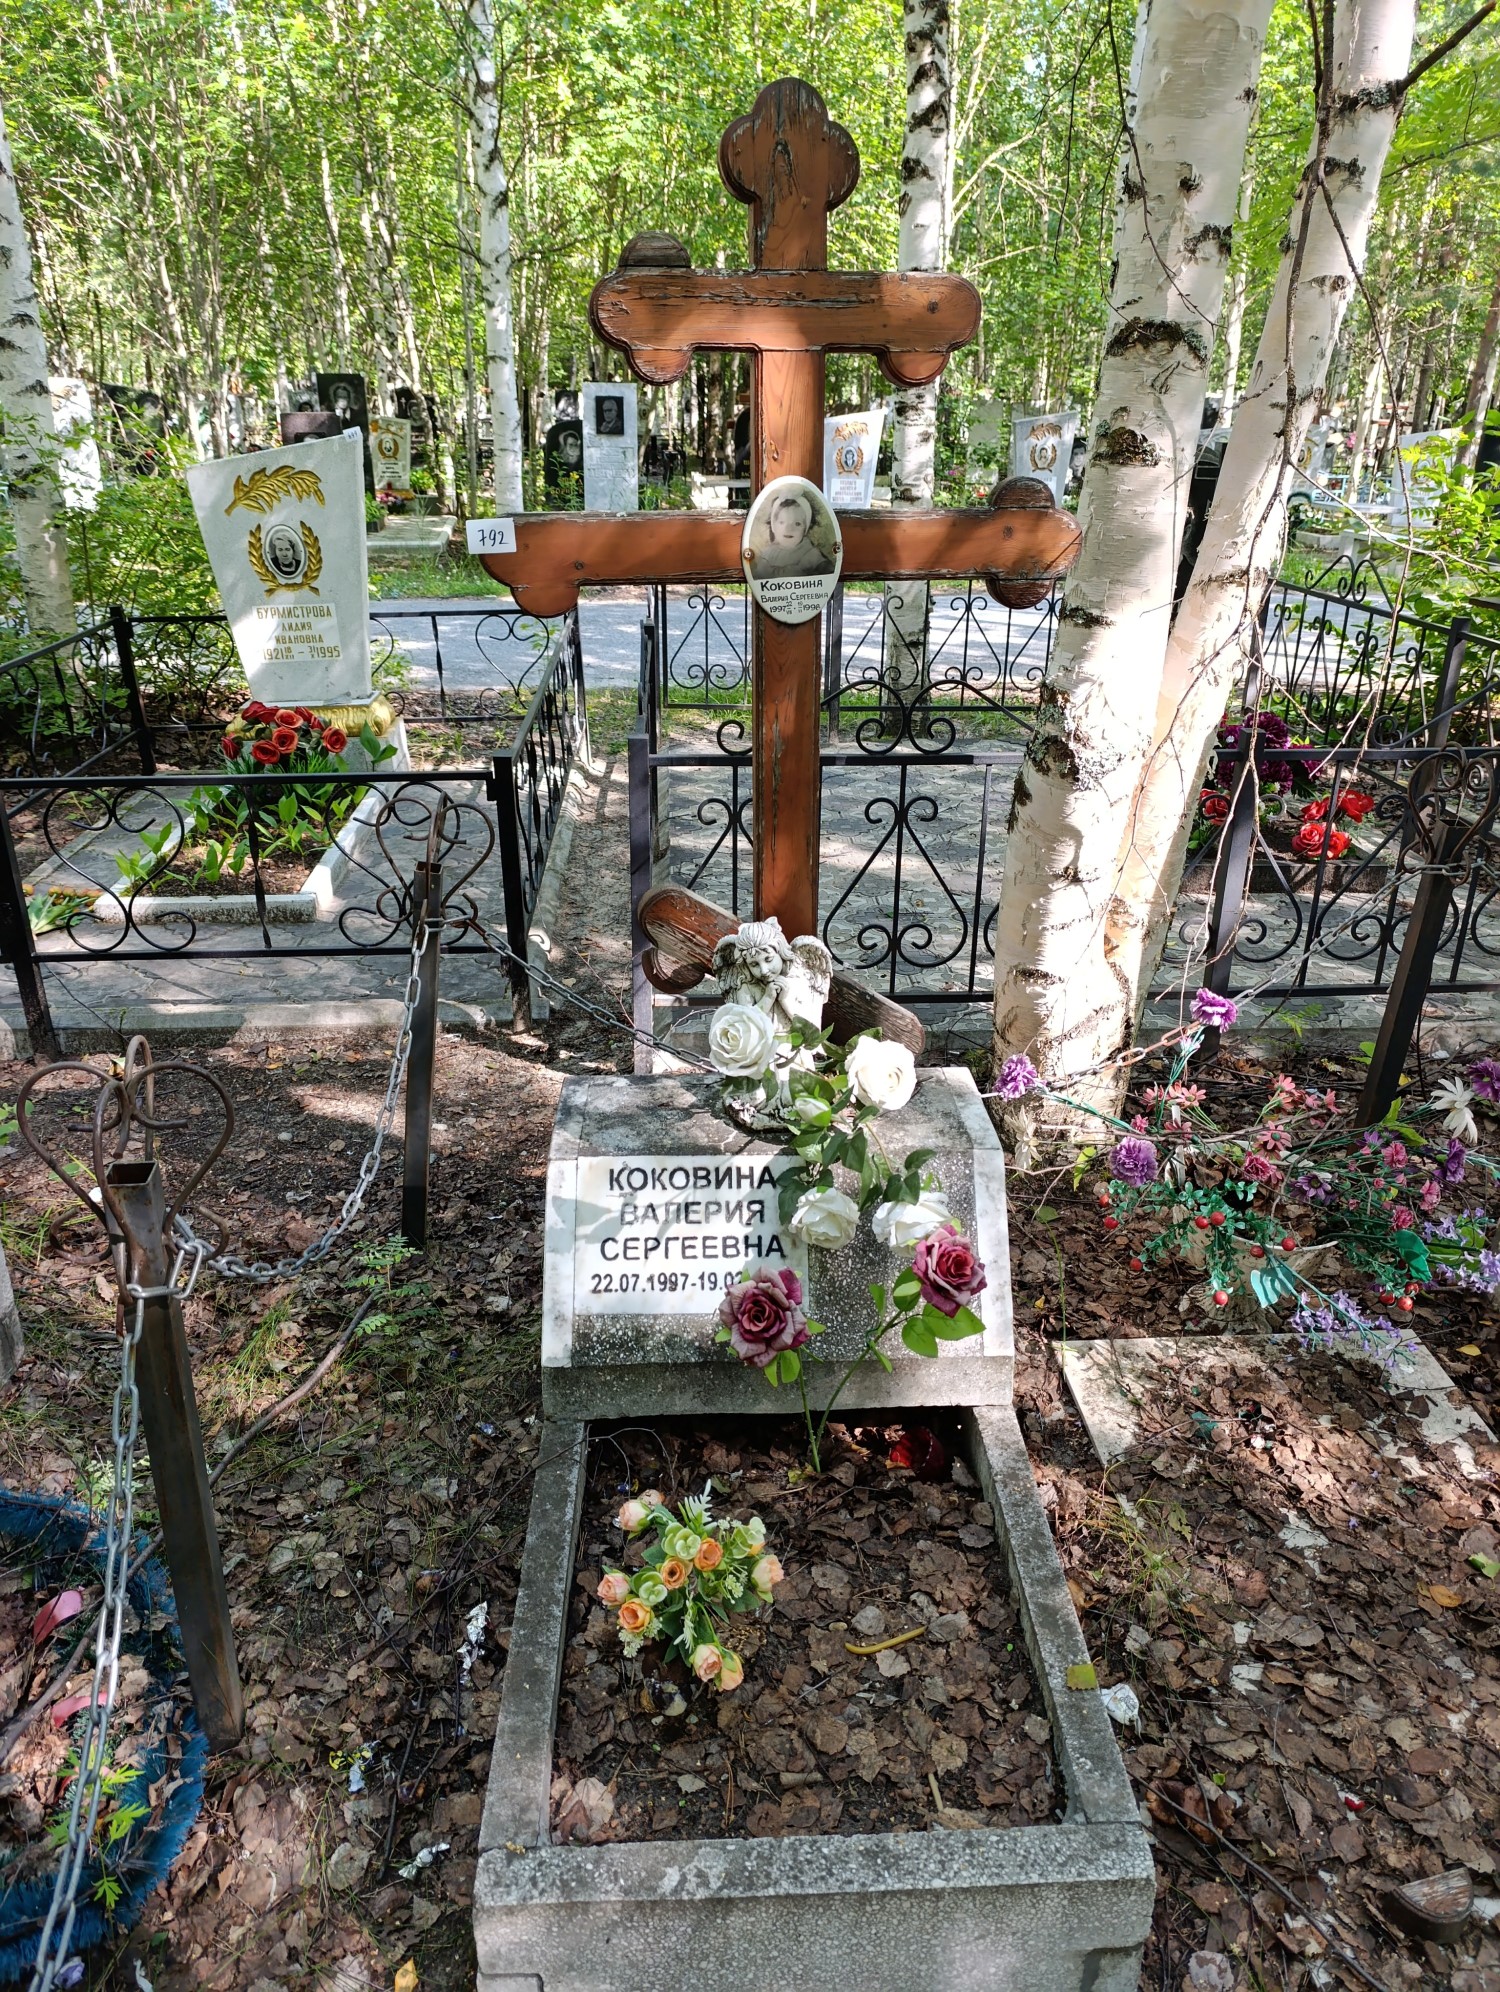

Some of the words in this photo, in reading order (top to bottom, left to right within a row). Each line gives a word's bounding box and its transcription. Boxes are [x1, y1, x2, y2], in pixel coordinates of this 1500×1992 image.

[477, 528, 510, 547] 792
[760, 579, 823, 592] КОКОВИНА
[256, 605, 333, 620] БУРМИСТРОВА
[281, 621, 313, 632] ЛИДИЯ
[274, 633, 325, 645] ИВАНОВНА
[263, 648, 284, 660] 1921
[316, 645, 342, 659] 1995
[608, 1165, 777, 1193] КОКОВИНА
[620, 1199, 765, 1227] ВАЛЕРИЯ
[599, 1234, 787, 1262] СЕРГЕЕВНА
